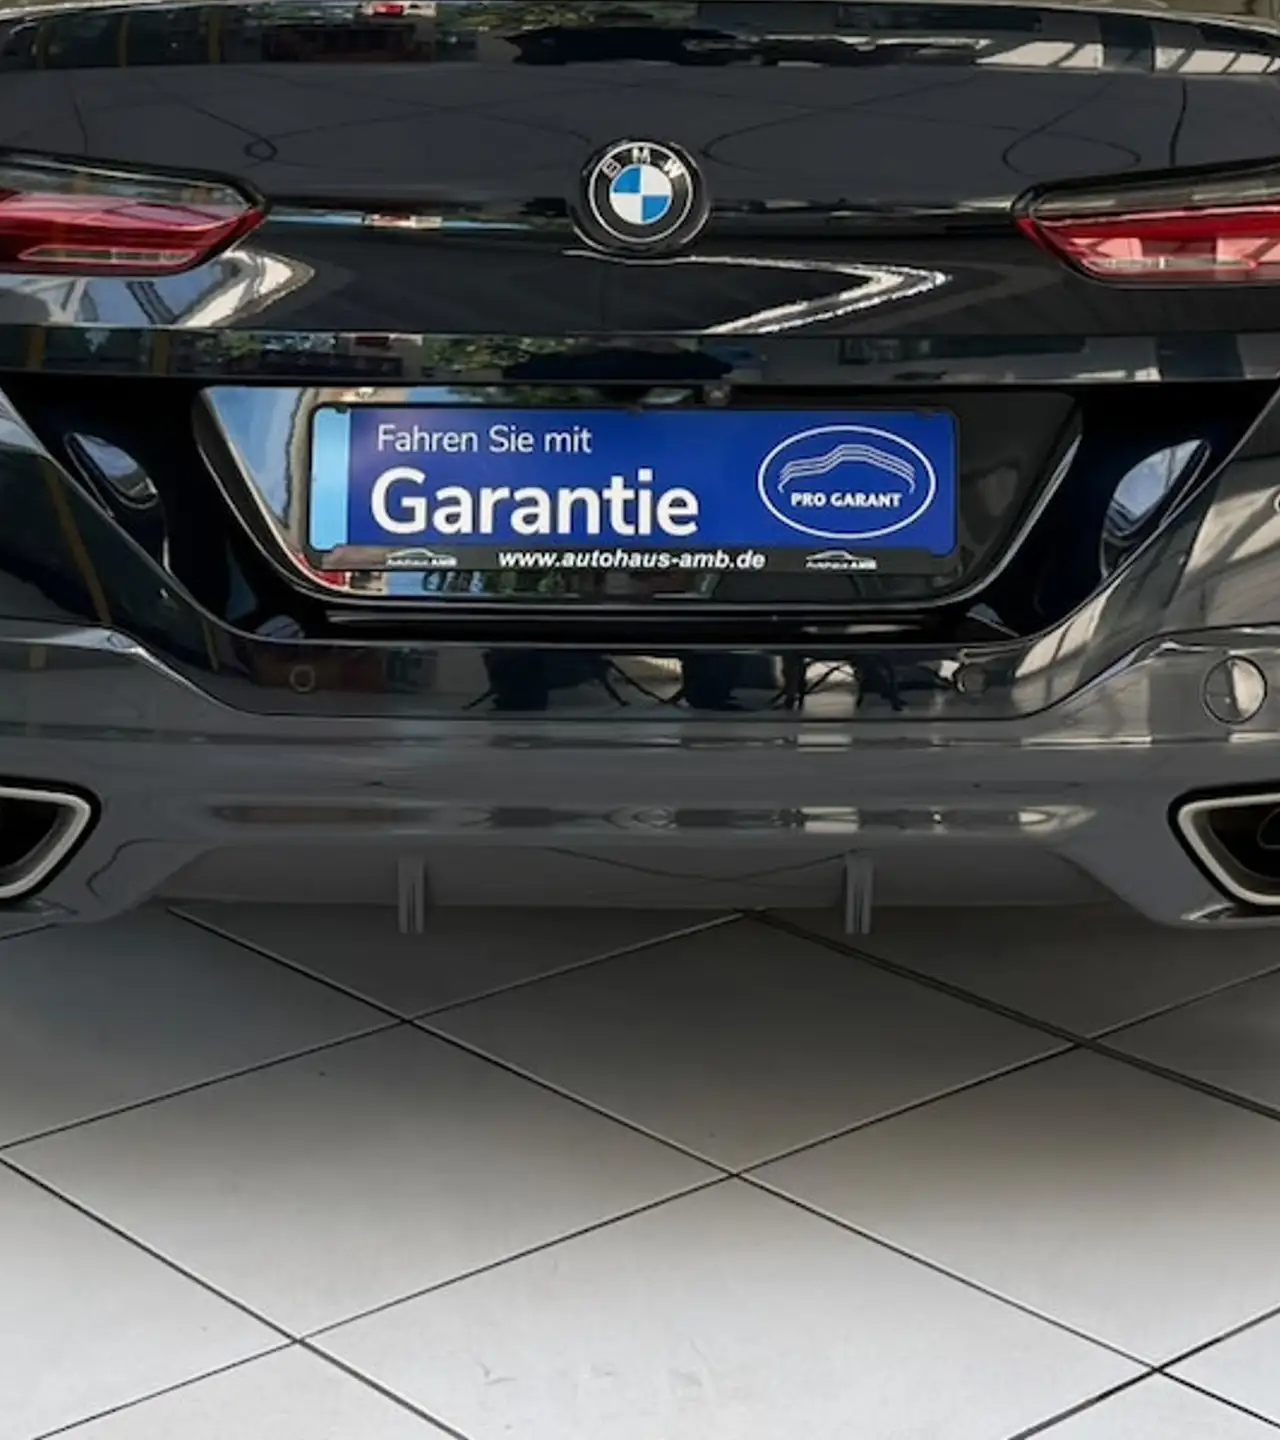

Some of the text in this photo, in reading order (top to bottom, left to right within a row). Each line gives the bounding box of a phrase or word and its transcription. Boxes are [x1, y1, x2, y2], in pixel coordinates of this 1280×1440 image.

[602, 146, 686, 180] BMW
[376, 423, 593, 454] Fahren Sie mit
[370, 466, 700, 537] Garantie
[790, 491, 902, 508] PRO GARANT
[498, 547, 766, 569] www.autohaus-amb.de
